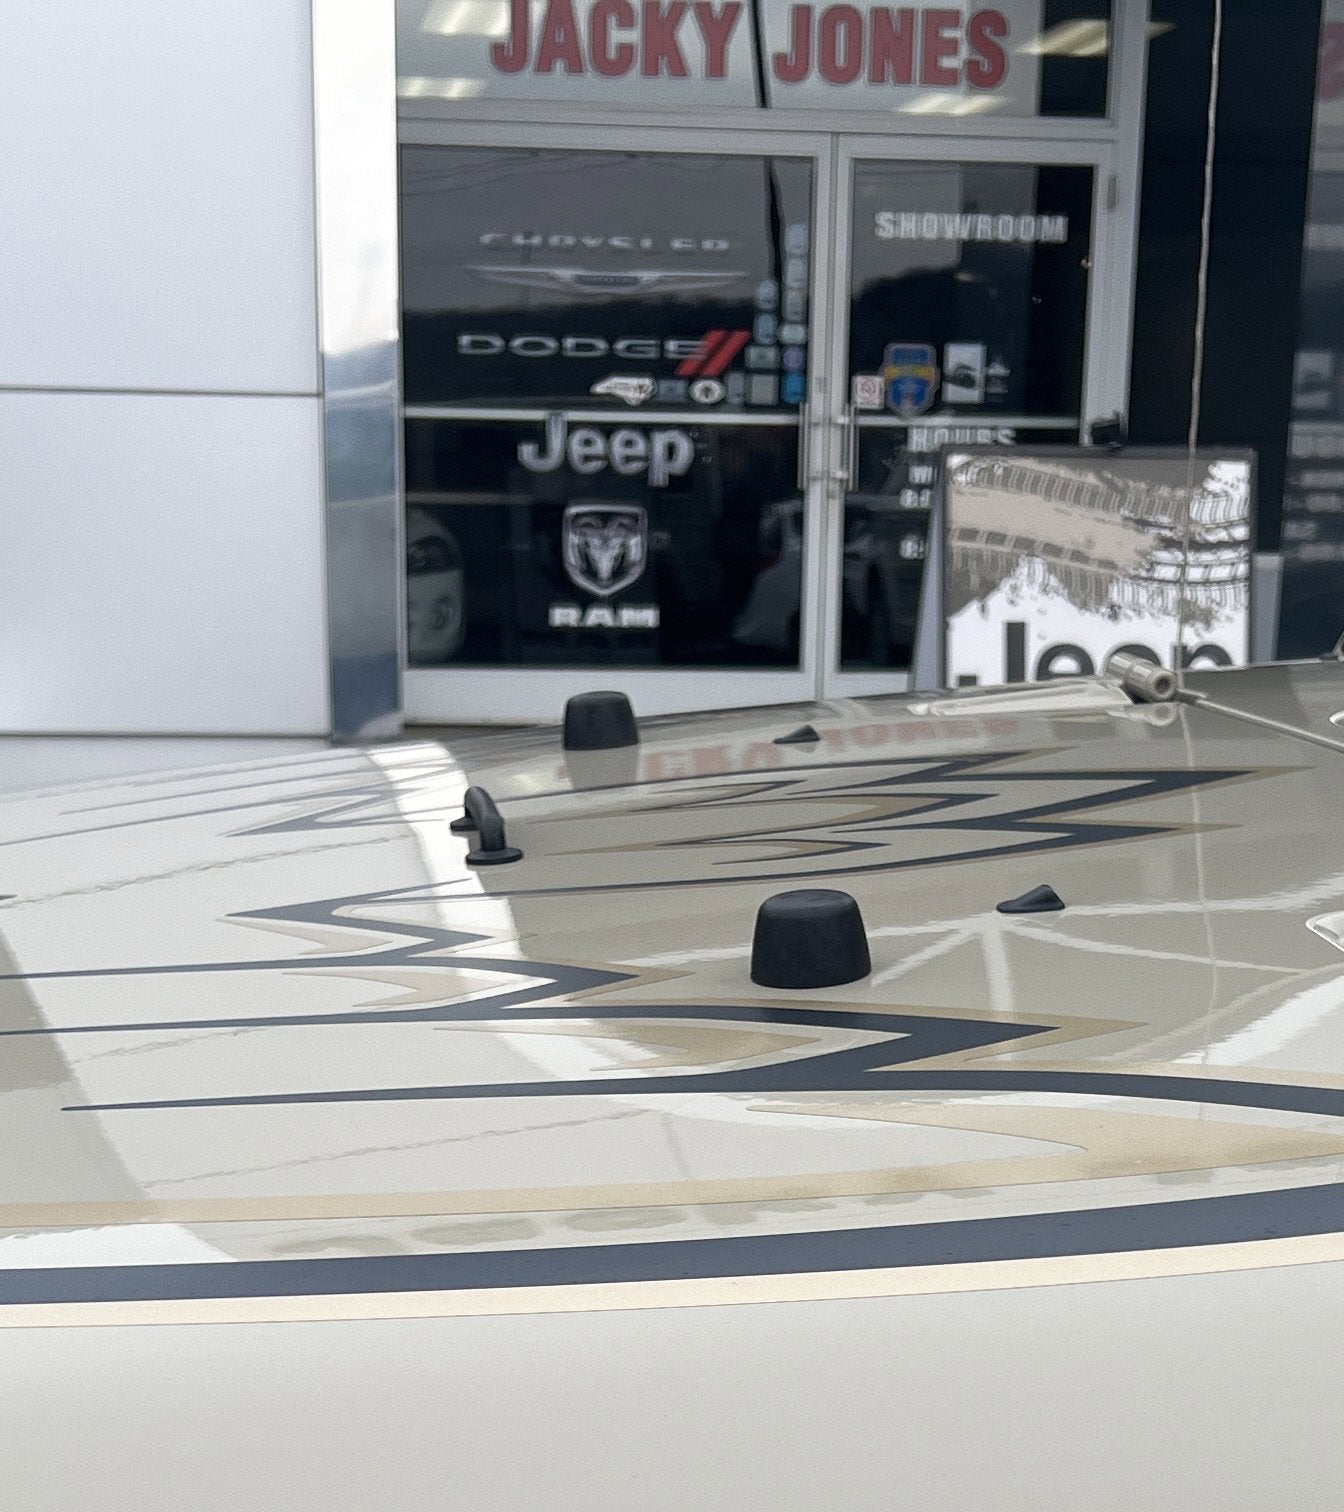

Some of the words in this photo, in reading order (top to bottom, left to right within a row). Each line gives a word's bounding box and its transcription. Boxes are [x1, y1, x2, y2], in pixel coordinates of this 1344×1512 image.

[489, 0, 741, 80] JACKY
[773, 3, 1010, 89] JONES
[874, 211, 1068, 244] SHOWROOM
[457, 332, 709, 360] DODGE
[517, 413, 695, 487] Jeep
[548, 606, 660, 628] RAM
